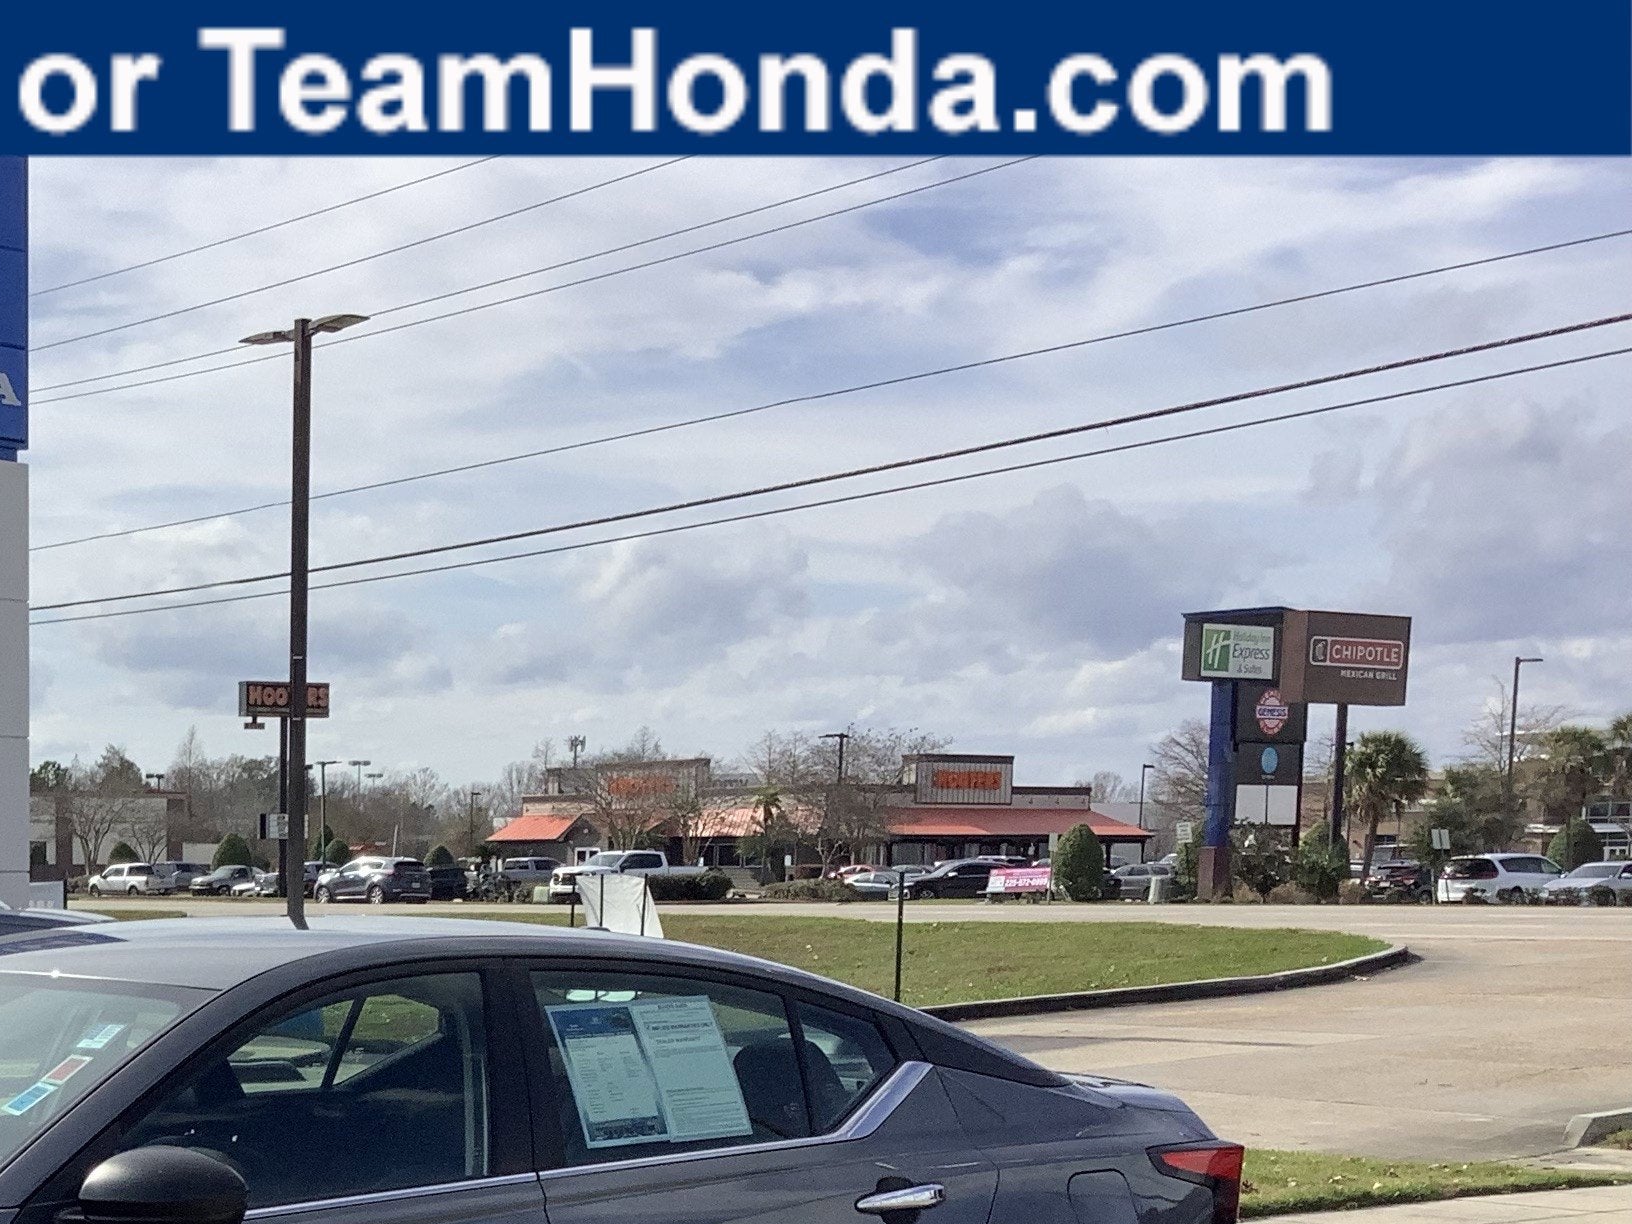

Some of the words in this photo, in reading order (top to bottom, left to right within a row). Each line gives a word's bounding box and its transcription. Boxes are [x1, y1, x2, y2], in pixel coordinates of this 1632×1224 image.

[1232, 643, 1270, 661] Express
[1332, 645, 1399, 662] CHIPOTLE
[1340, 669, 1374, 678] MEXICAN
[248, 685, 328, 707] HOORS
[1257, 708, 1287, 717] GENESIS
